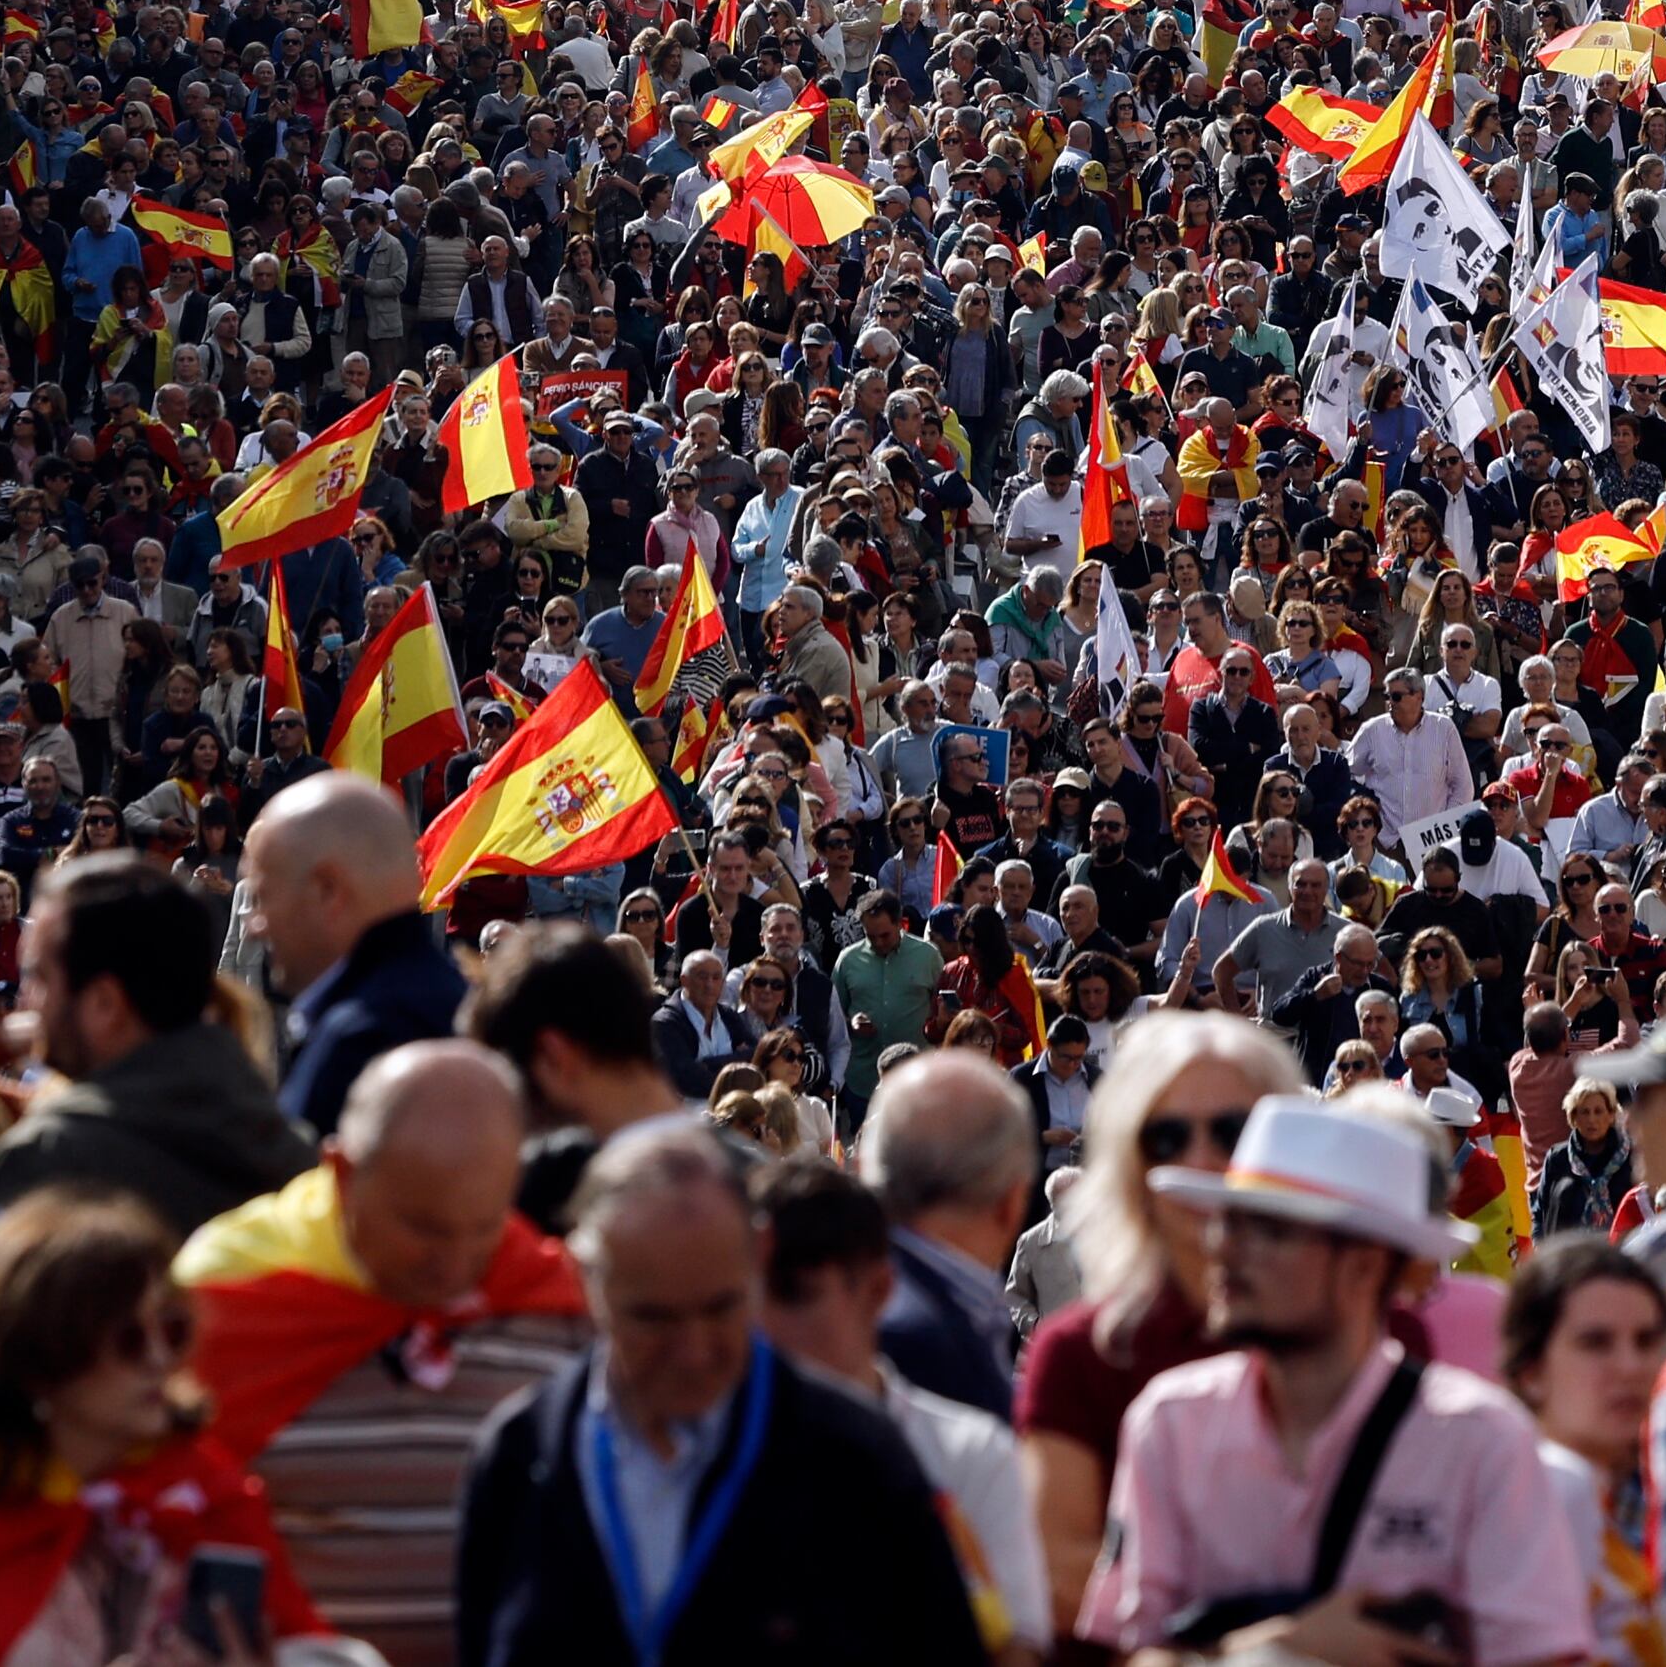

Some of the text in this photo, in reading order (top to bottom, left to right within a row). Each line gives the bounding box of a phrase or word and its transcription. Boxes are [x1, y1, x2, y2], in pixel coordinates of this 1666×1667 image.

[543, 379, 622, 395] PEDRO SÁNCHEZ
[1536, 355, 1598, 435] EN TU MEMORIA
[1419, 823, 1453, 847] MÁS
